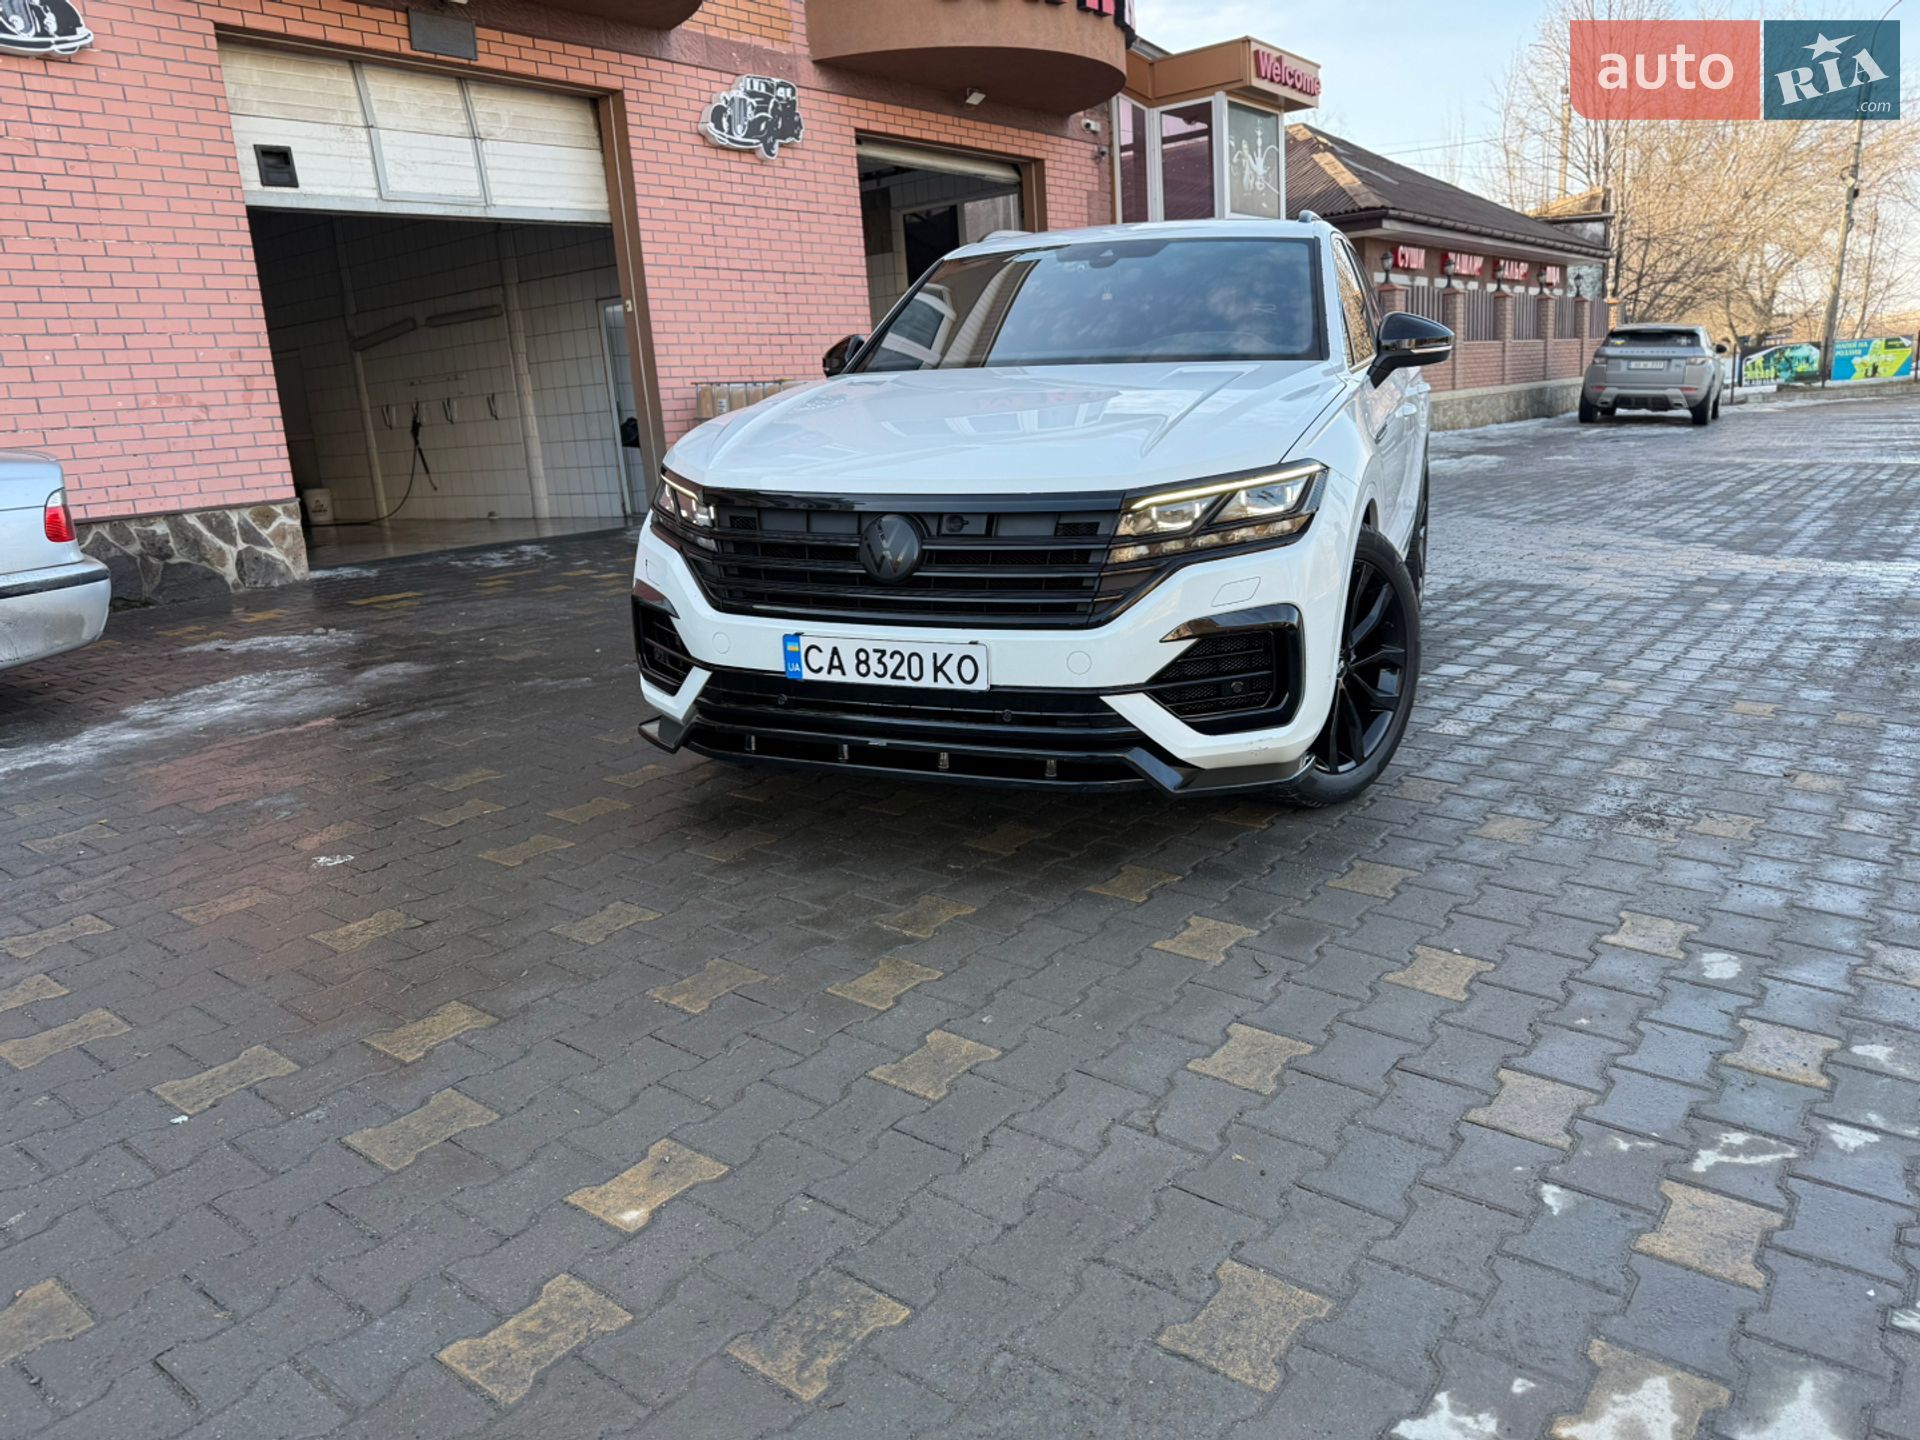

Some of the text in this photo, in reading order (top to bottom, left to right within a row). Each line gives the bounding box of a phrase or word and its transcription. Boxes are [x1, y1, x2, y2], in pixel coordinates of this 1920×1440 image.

[1254, 50, 1321, 97] Welcome
[786, 644, 980, 685] UA CA 8320 KO
